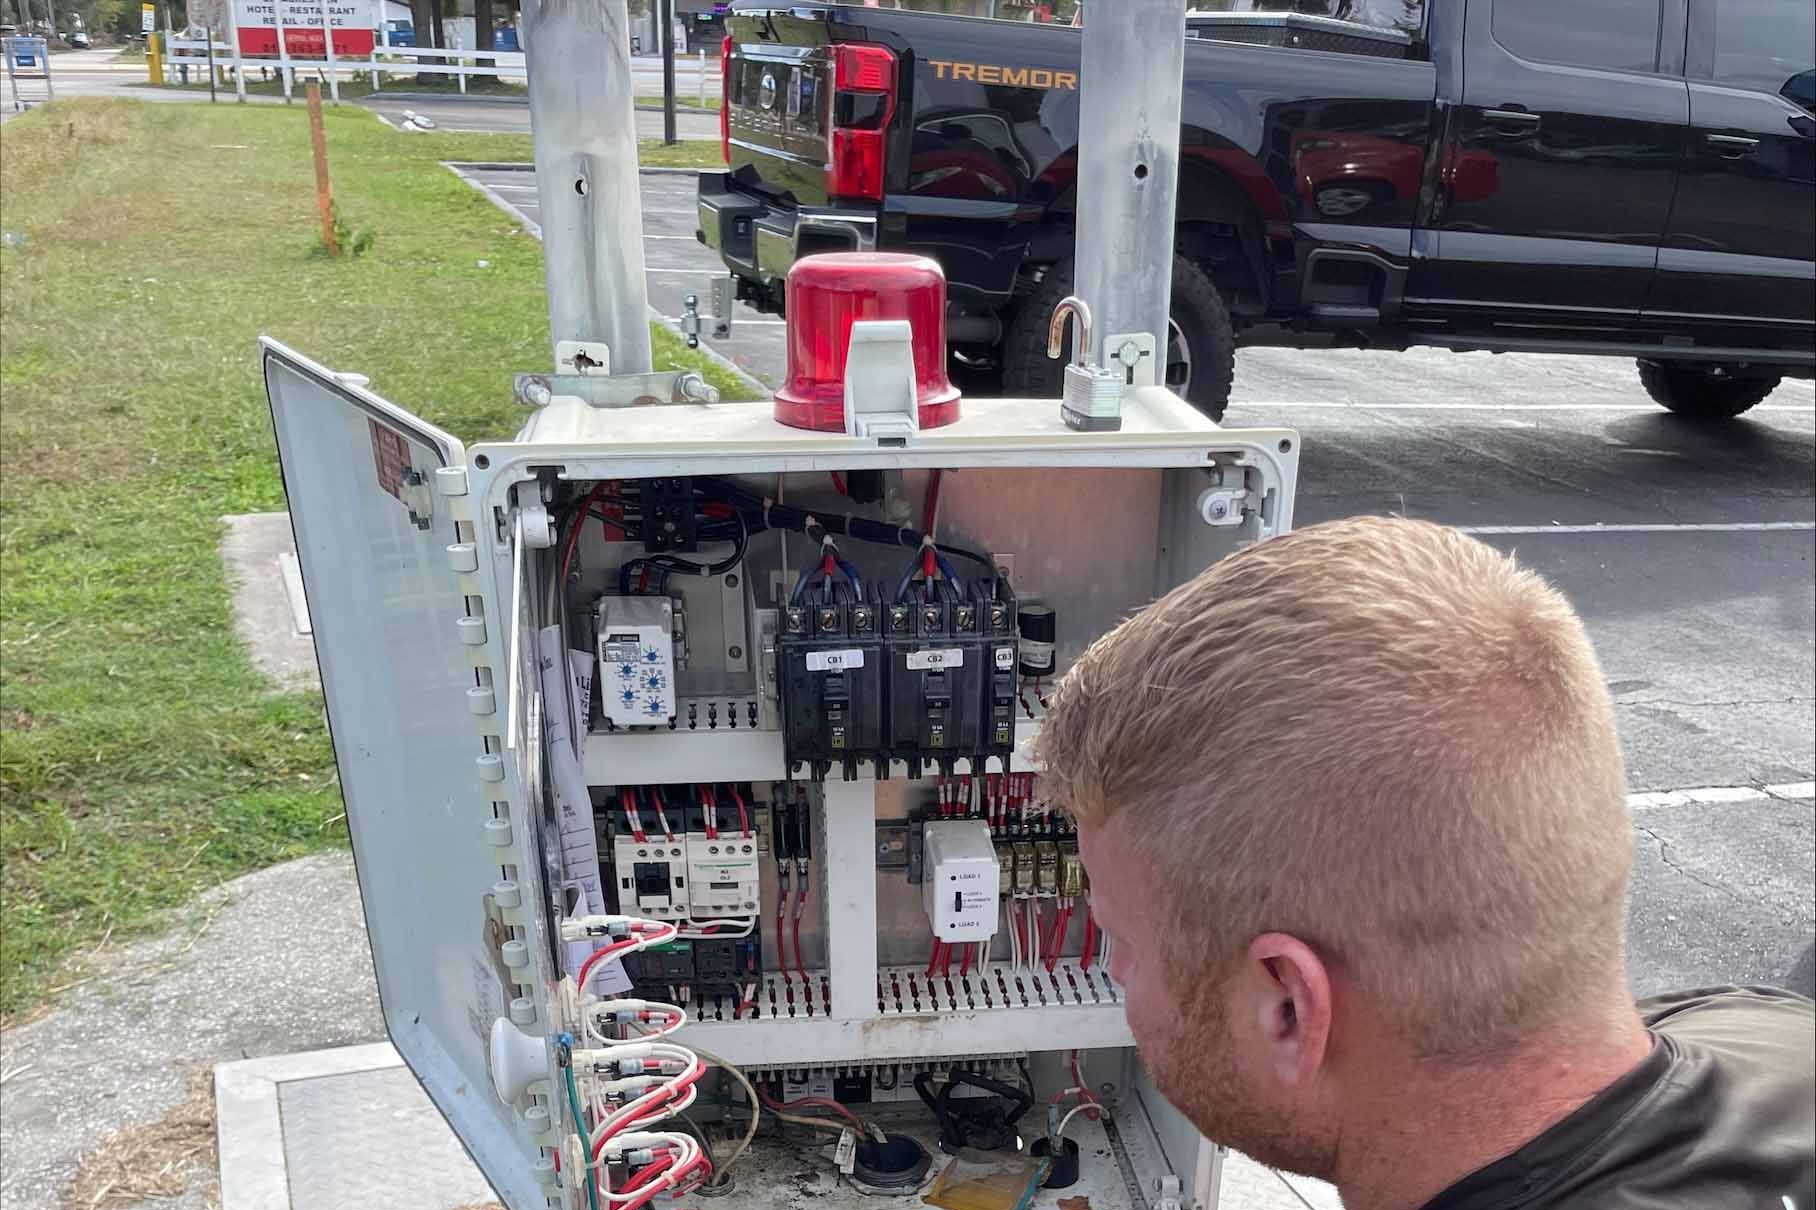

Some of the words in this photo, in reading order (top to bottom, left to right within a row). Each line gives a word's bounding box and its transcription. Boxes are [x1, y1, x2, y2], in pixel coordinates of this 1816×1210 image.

[247, 6, 275, 14] HOTE
[290, 7, 355, 15] RESTARANT
[263, 17, 297, 25] REAIL
[928, 60, 1076, 90] TREMOR
[827, 656, 842, 664] CB1
[927, 655, 942, 663] CB2
